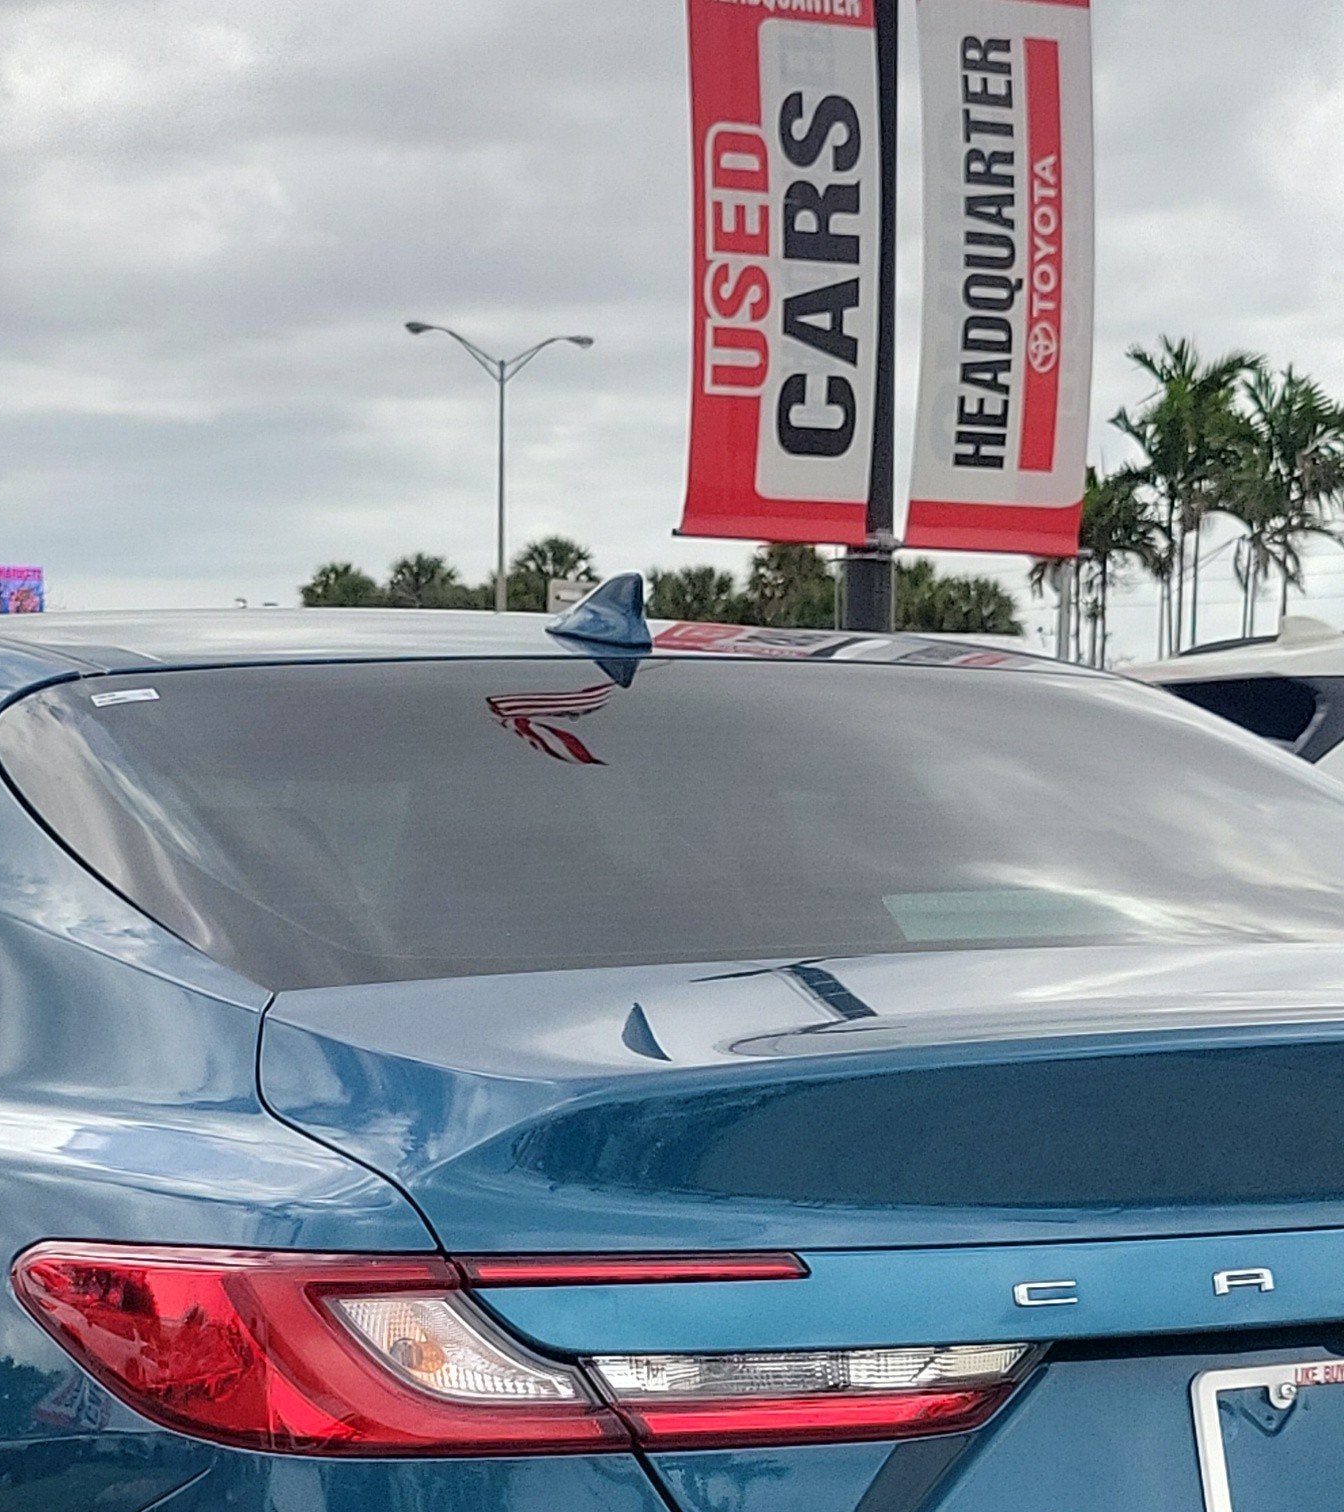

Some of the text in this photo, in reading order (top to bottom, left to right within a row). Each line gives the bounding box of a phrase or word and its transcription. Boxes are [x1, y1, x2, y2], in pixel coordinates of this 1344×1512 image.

[706, 125, 771, 394] USED
[775, 91, 862, 459] CARS
[954, 36, 1023, 470] HEADQUARTER
[1032, 155, 1058, 317] TOYOTA
[1294, 1366, 1318, 1385] LIKE
